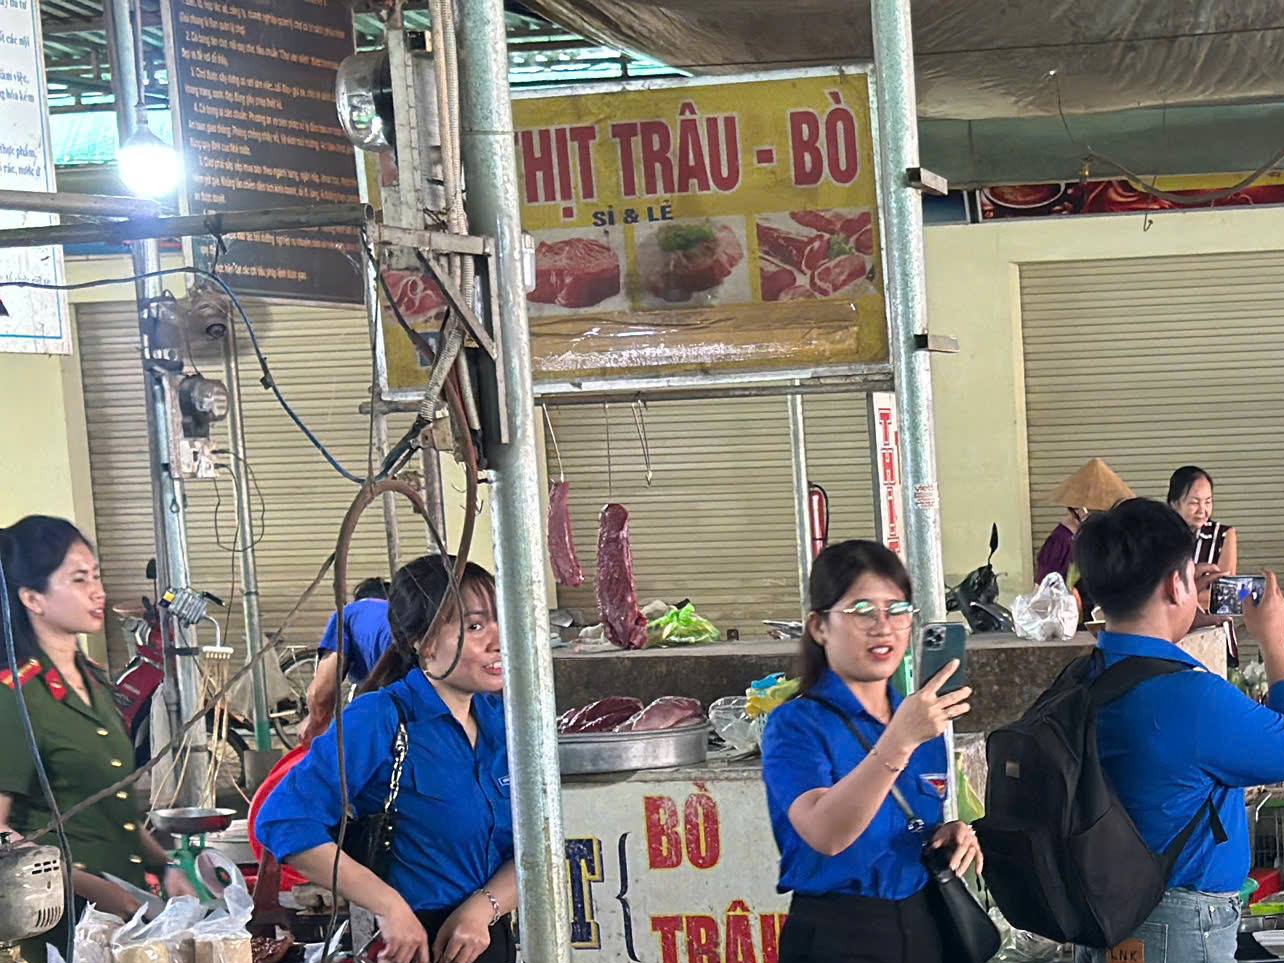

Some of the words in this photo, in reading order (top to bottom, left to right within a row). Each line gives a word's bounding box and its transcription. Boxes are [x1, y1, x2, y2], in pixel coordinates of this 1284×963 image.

[514, 127, 596, 218] HỊT
[611, 102, 740, 197] TRÂU
[756, 149, 775, 164] -
[790, 91, 858, 185] BÒ
[623, 208, 640, 224] &
[643, 781, 721, 870] BÒ
